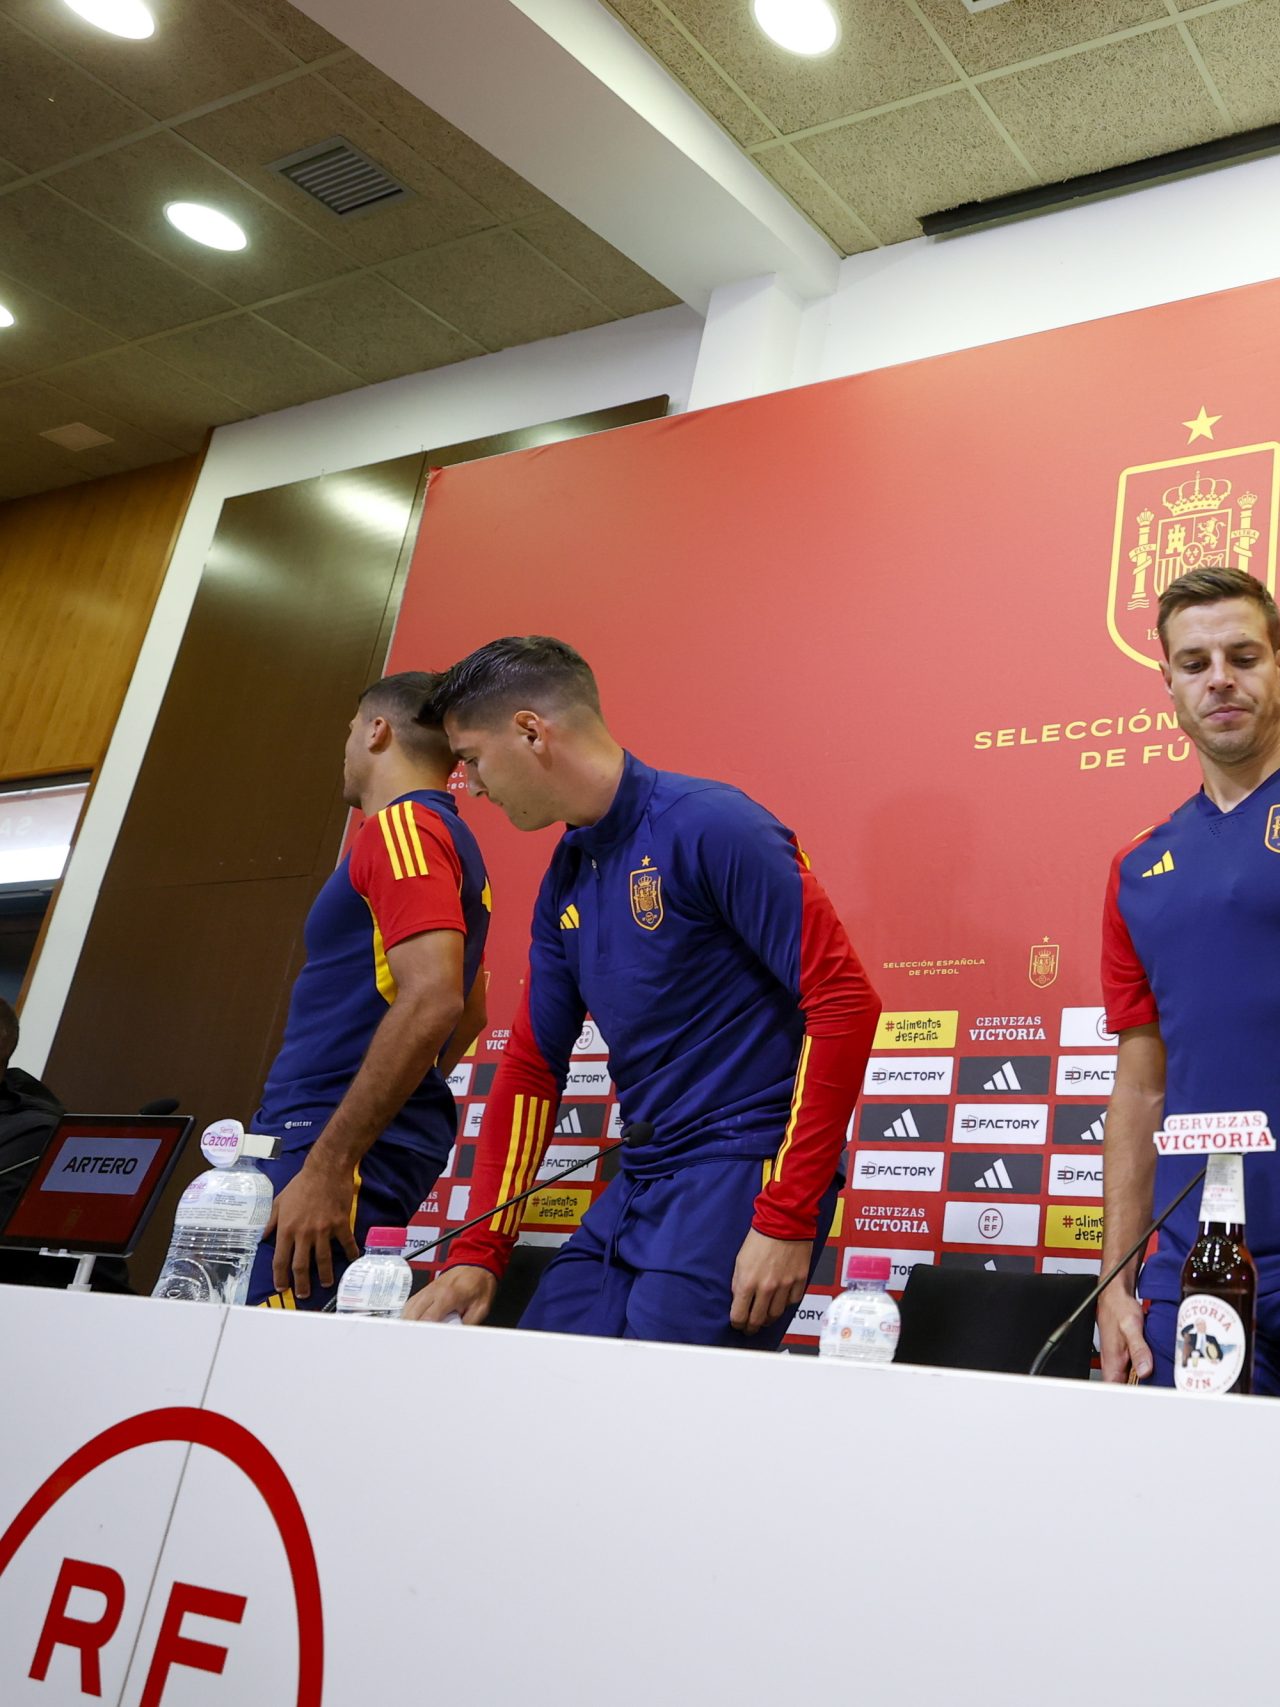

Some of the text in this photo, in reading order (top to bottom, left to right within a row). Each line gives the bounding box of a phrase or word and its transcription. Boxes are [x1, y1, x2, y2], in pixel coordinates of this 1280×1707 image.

[974, 707, 1179, 750] SELECCIÓN
[1079, 750, 1126, 770] DE
[885, 1017, 942, 1033] #alimentos
[976, 1015, 1041, 1027] CERVEZAS
[895, 1029, 939, 1043] despaña
[969, 1027, 1047, 1042] VICTORIA
[1167, 1114, 1263, 1131] CERVEZAS
[202, 1132, 238, 1147] Cazorla
[1158, 1131, 1272, 1151] VICTORIA
[62, 1156, 139, 1175] ARTERO
[861, 1205, 926, 1218] CERVEZAS
[855, 1218, 930, 1234] VICTORIA
